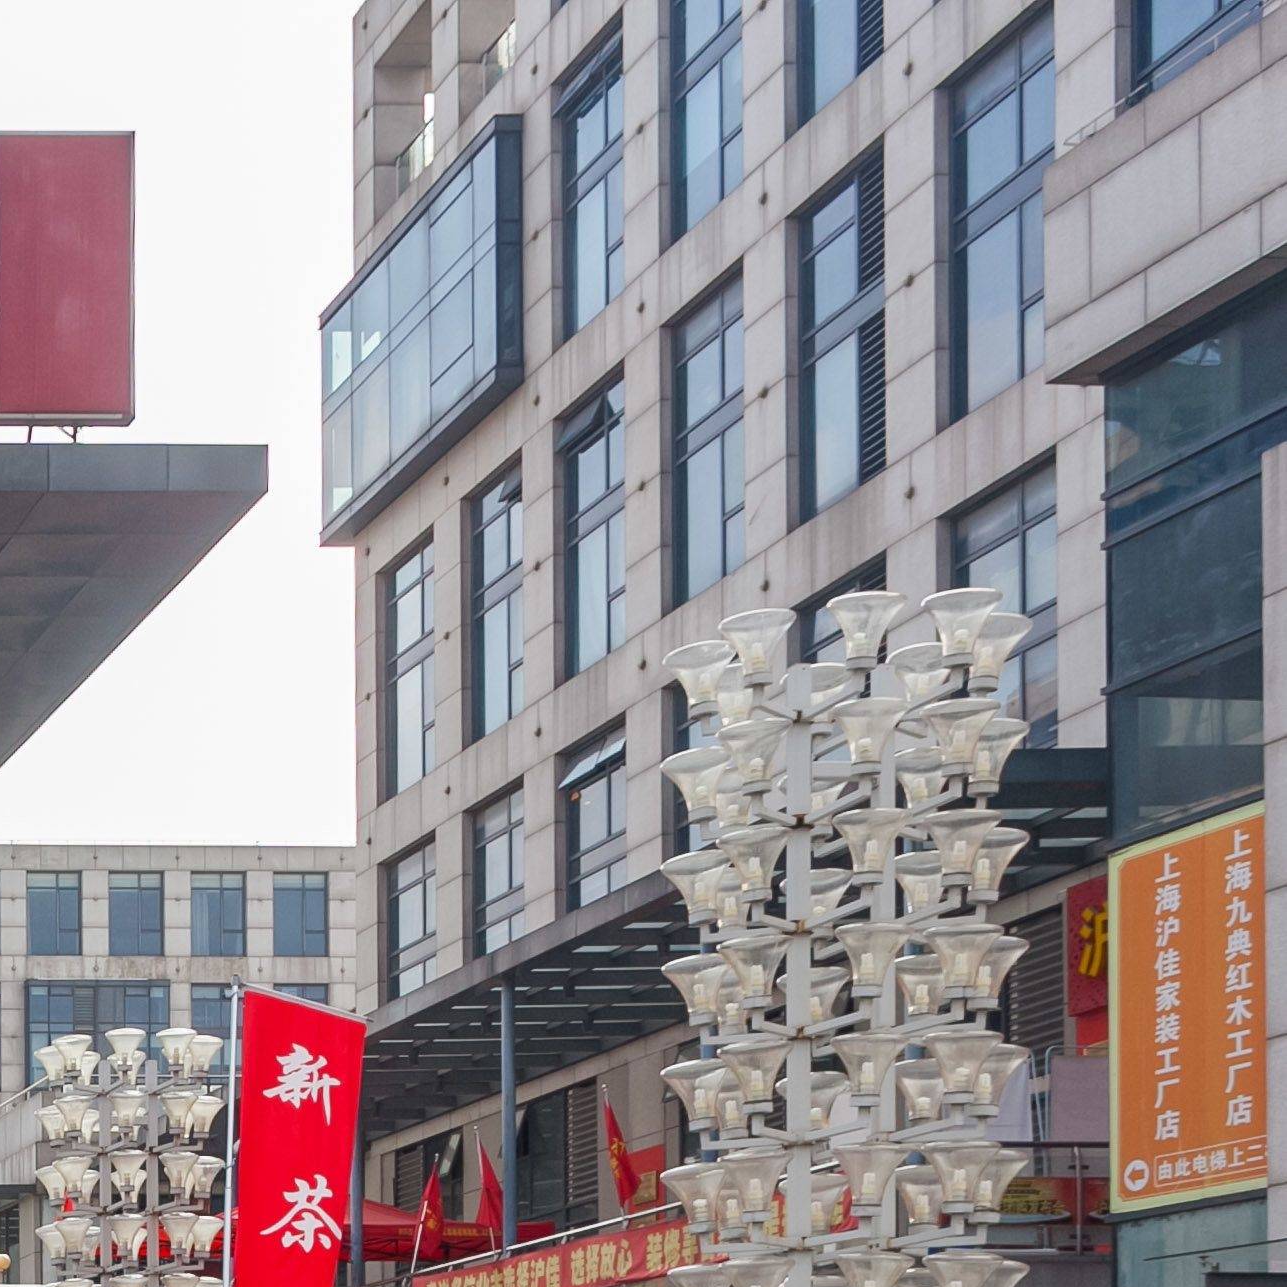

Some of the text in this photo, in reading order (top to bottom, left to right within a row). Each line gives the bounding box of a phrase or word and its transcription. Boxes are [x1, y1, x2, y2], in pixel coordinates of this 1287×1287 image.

[1153, 852, 1183, 1141] 上海沪佳家装工厂店
[1224, 828, 1253, 1127] 上海九典红木工厂店
[1157, 1144, 1267, 1181] 由此电梯上二
